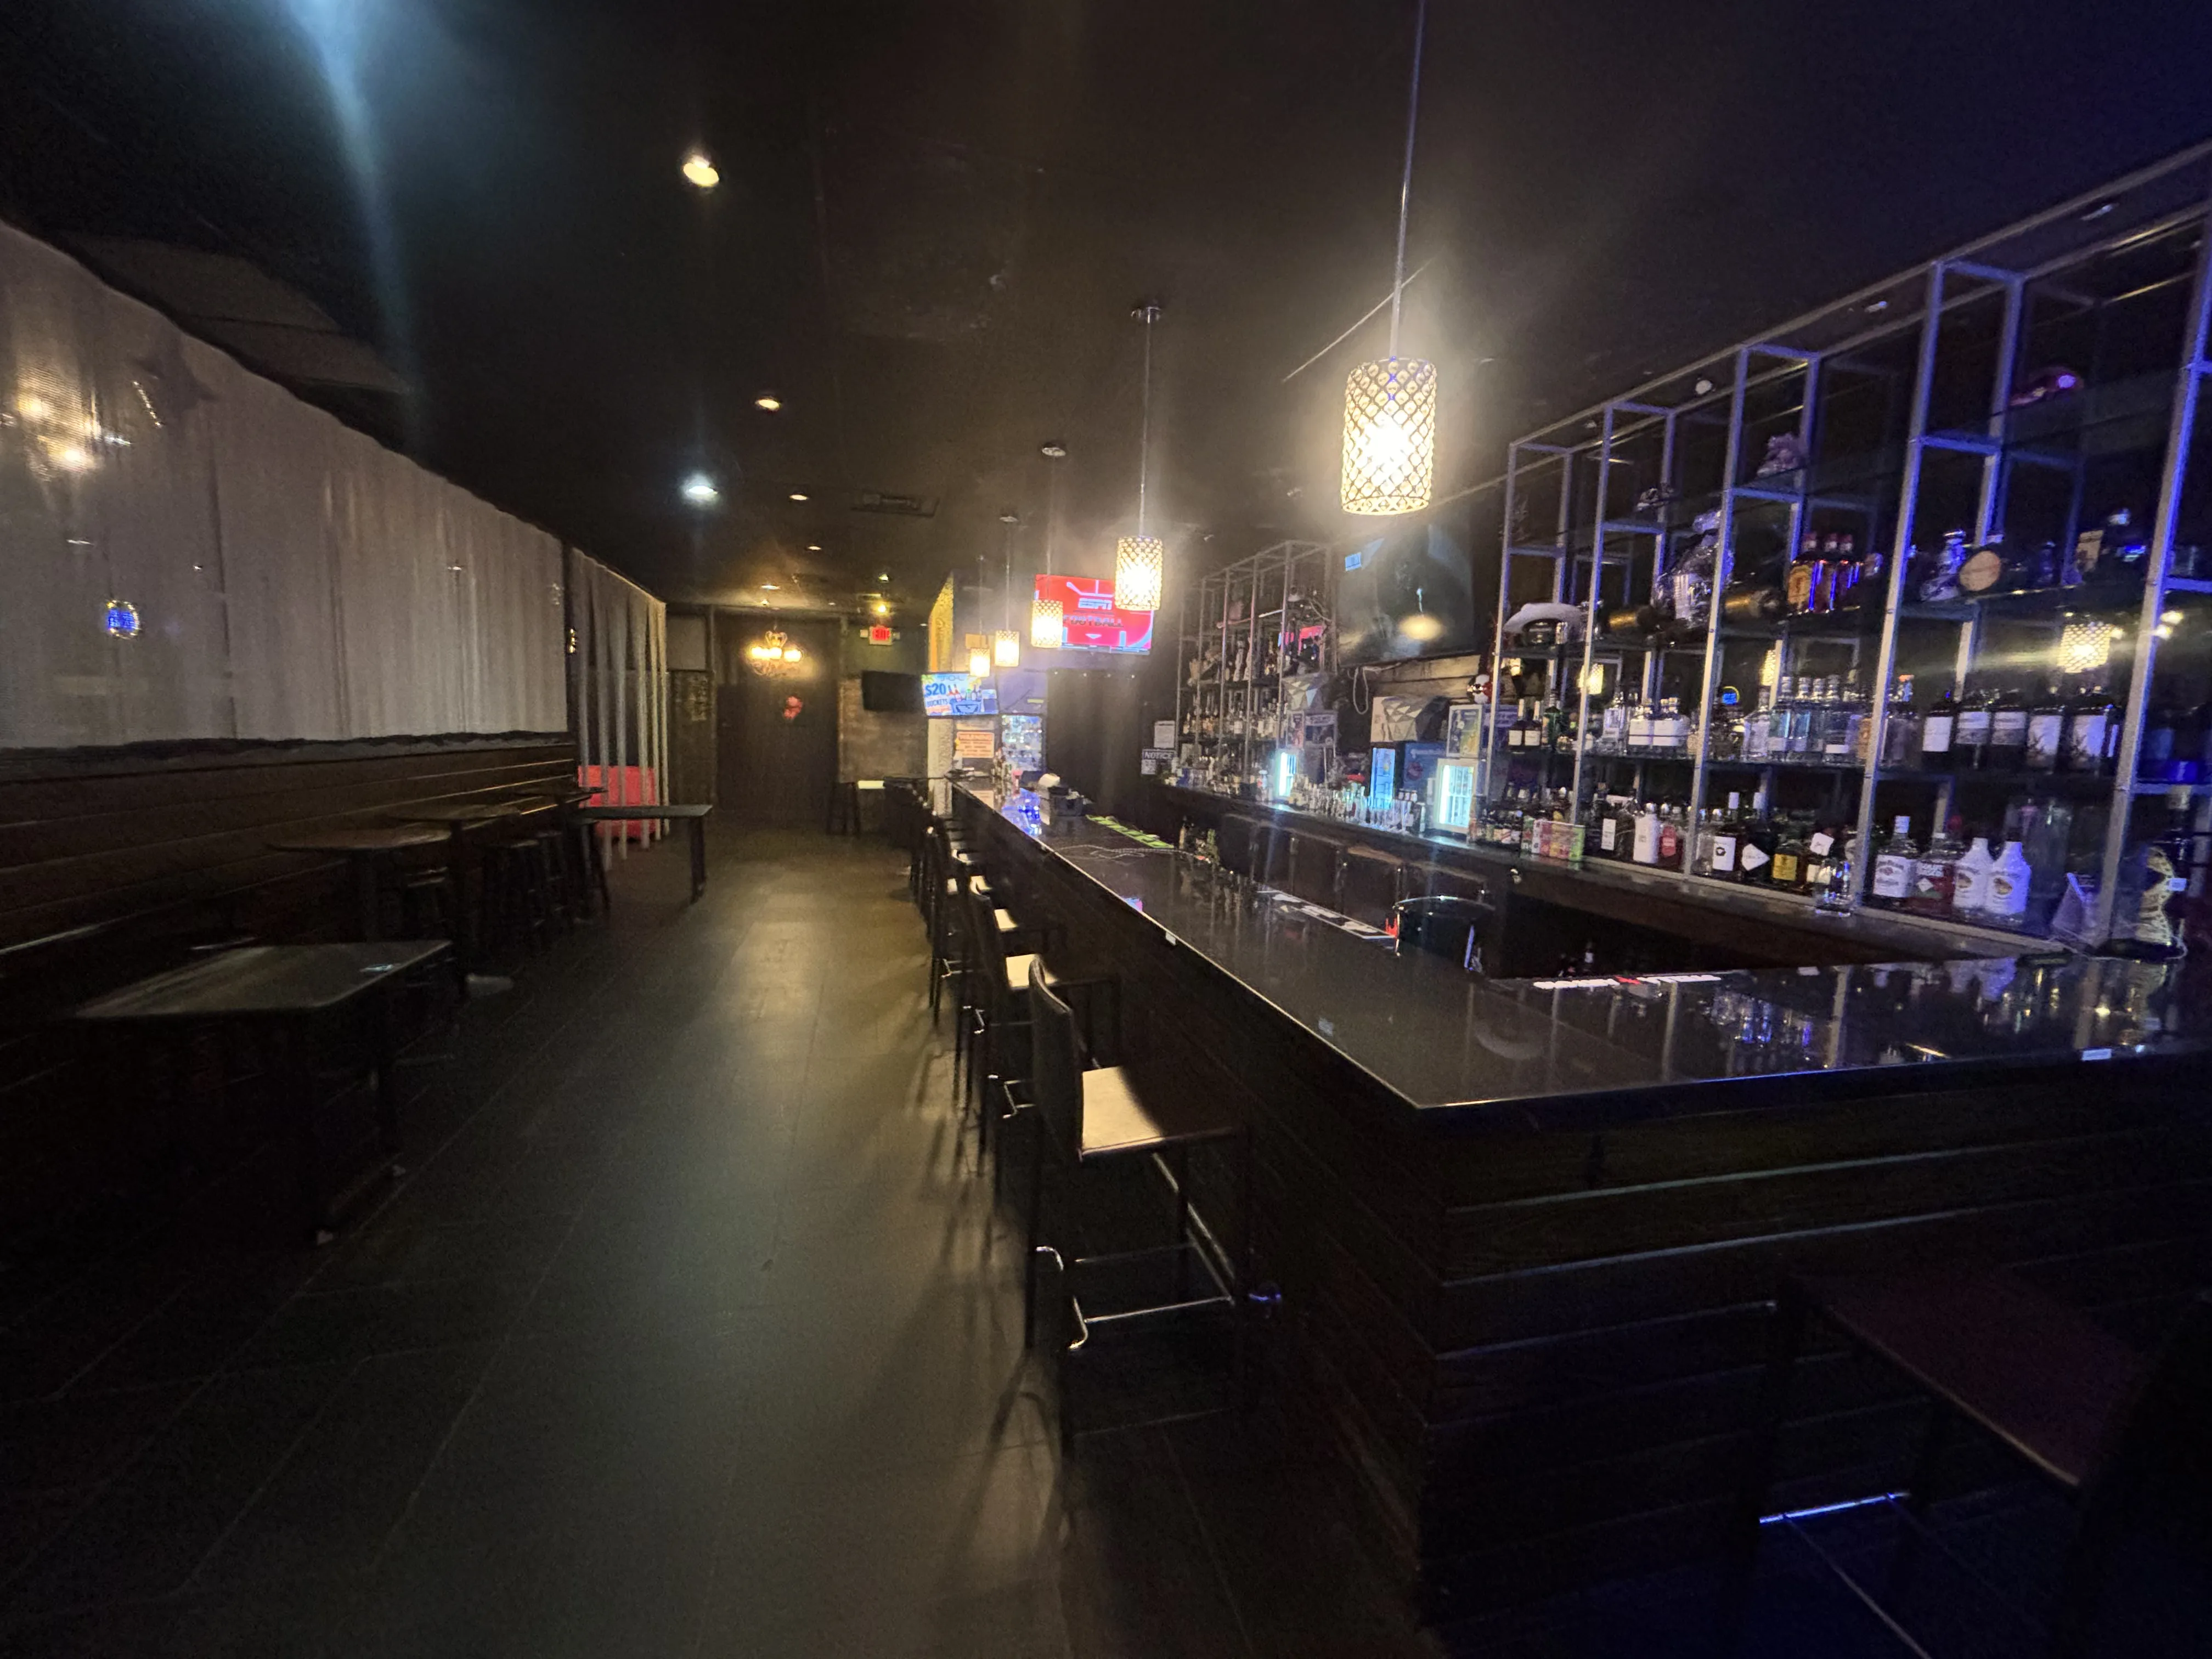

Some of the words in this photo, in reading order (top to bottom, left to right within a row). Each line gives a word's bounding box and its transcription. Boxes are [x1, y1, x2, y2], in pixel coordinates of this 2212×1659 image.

[1078, 598, 1113, 610] ESPN
[1063, 614, 1123, 628] FOOTBALL
[872, 629, 890, 640] EXIT
[924, 682, 947, 697] $20
[927, 698, 949, 707] BUCKETS
[1144, 751, 1173, 759] NOTICE
